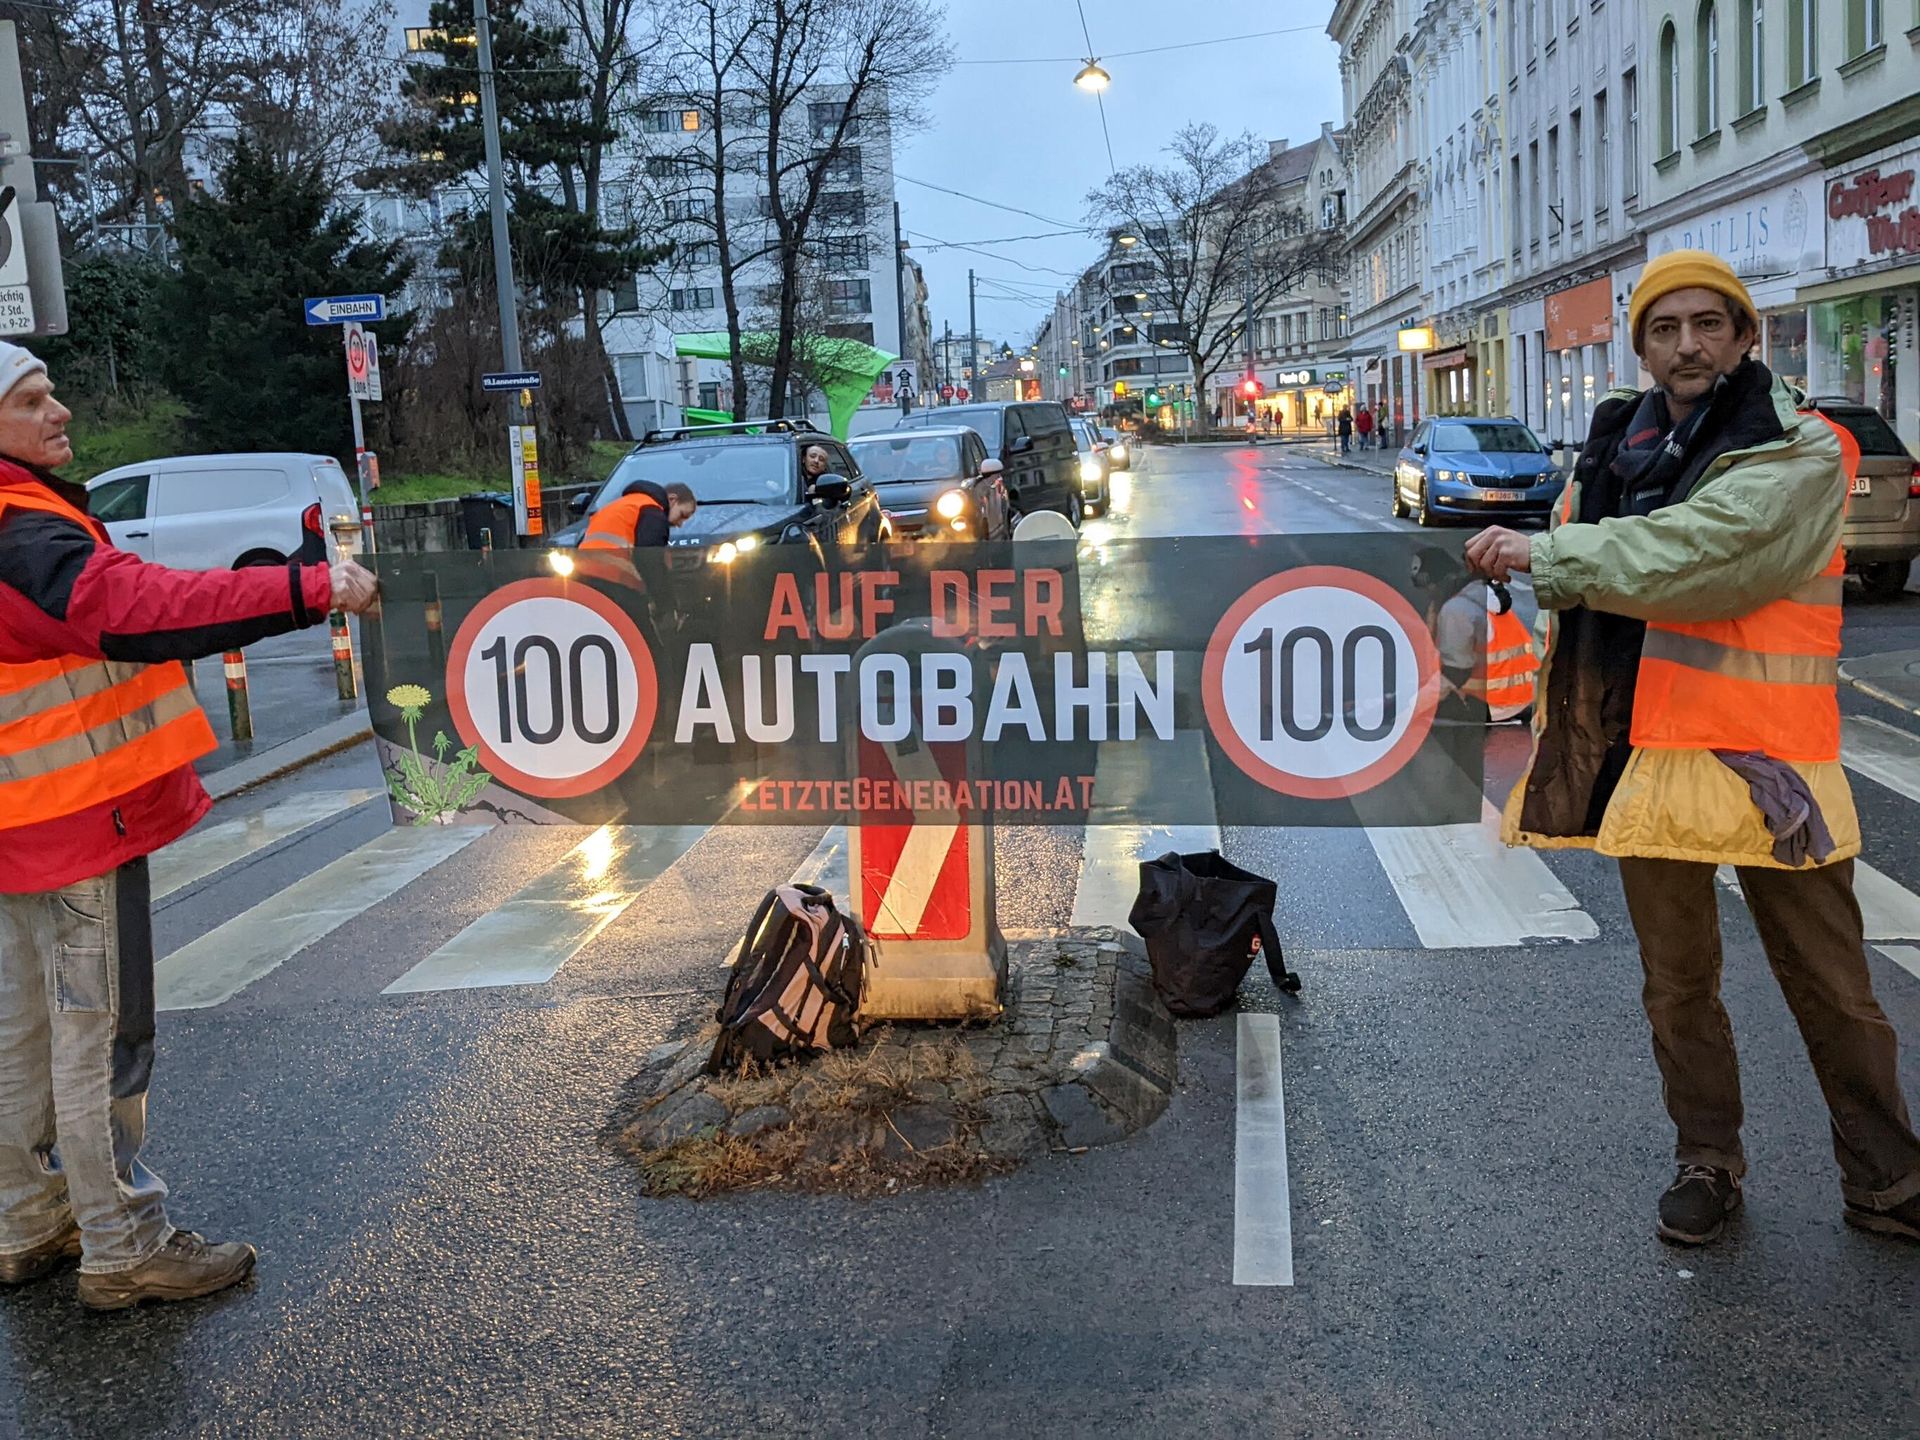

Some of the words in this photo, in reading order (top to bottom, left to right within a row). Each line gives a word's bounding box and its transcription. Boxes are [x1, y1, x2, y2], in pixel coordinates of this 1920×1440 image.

[8, 305, 24, 316] Std.
[329, 302, 373, 315] EINBAHN
[667, 538, 700, 547] VER
[763, 571, 900, 640] AUF
[930, 568, 1063, 638] DER
[480, 634, 621, 744] 100
[674, 643, 1175, 744] AUTOBAHN
[1243, 624, 1398, 743] 100
